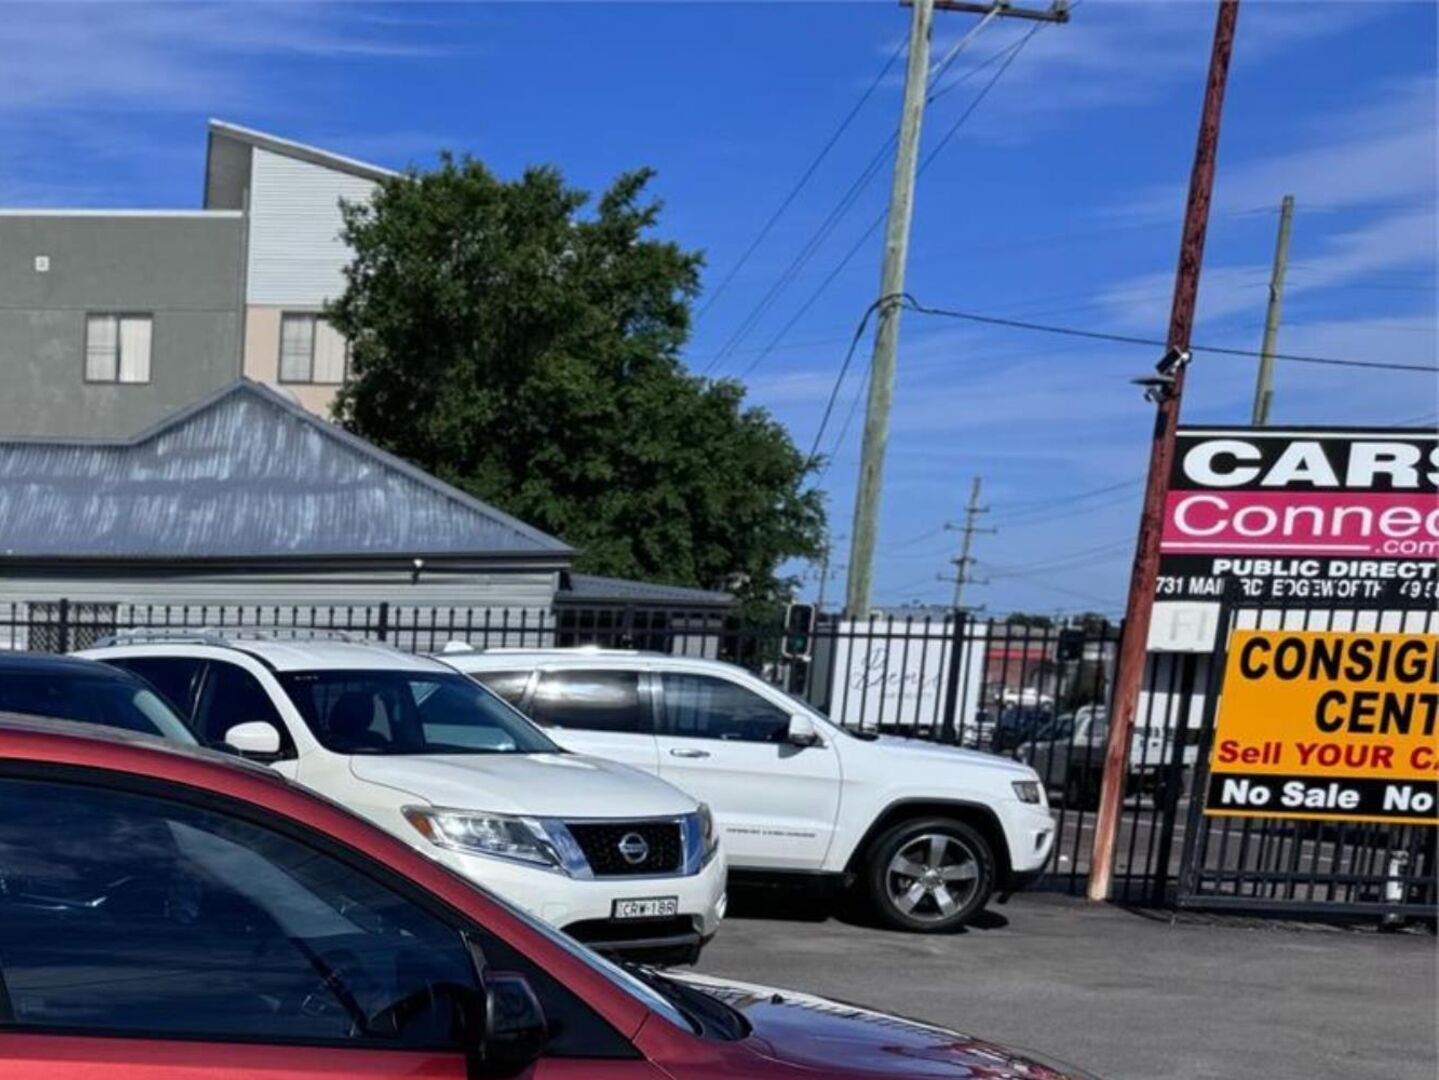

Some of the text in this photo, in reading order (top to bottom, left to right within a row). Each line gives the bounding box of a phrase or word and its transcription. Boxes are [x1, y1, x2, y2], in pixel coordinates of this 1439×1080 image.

[1183, 439, 1439, 488] CAR
[1155, 576, 1183, 594] 731
[1212, 559, 1437, 579] PUBLIC DIRECT
[1240, 636, 1439, 684] CONSIG
[1315, 689, 1439, 736] CENT
[1218, 740, 1439, 771] Sell YOUR C
[1221, 778, 1434, 812] No Sale No
